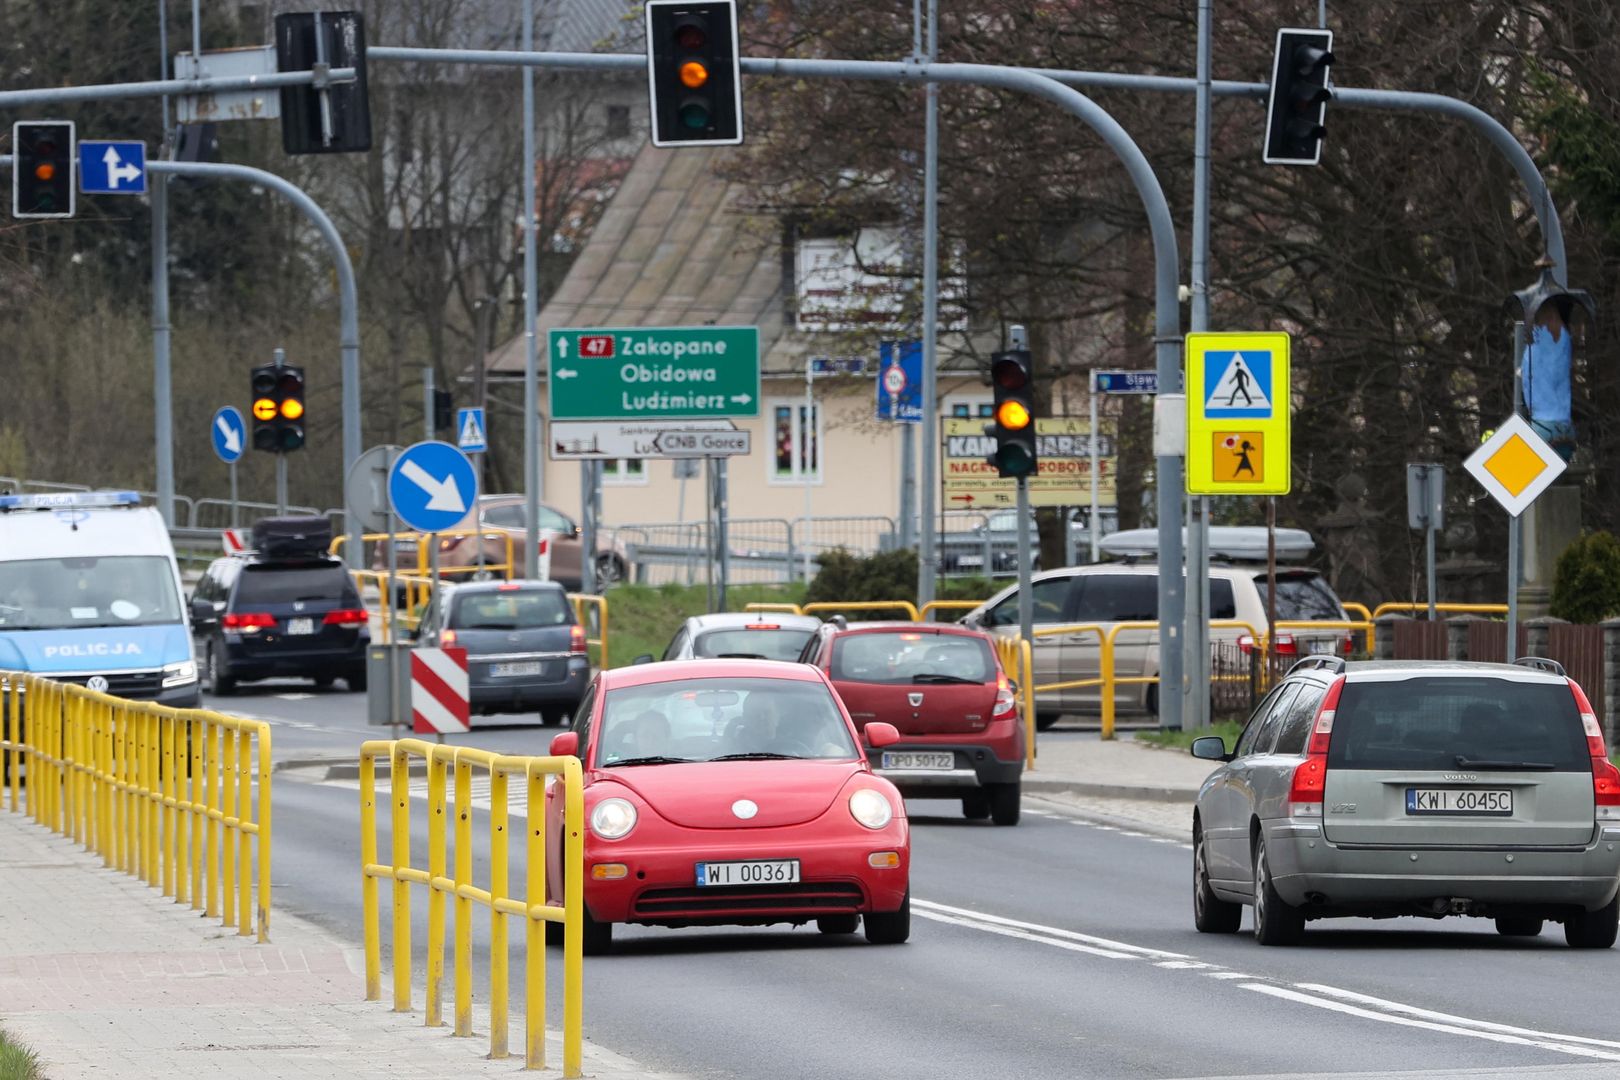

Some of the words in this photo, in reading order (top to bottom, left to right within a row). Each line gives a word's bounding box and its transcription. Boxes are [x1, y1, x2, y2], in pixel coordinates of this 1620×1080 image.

[586, 339, 607, 354] 47
[621, 336, 727, 360] Zakopane
[620, 363, 717, 383] Obidowa
[622, 391, 726, 410] Ludźmierz
[664, 434, 697, 449] CNB
[701, 434, 746, 449] Gorce
[44, 643, 142, 657] POLICJA
[1417, 792, 1447, 809] KWI
[1456, 792, 1509, 809] 6045C
[708, 865, 730, 883] WI
[741, 863, 794, 882] 0036J
